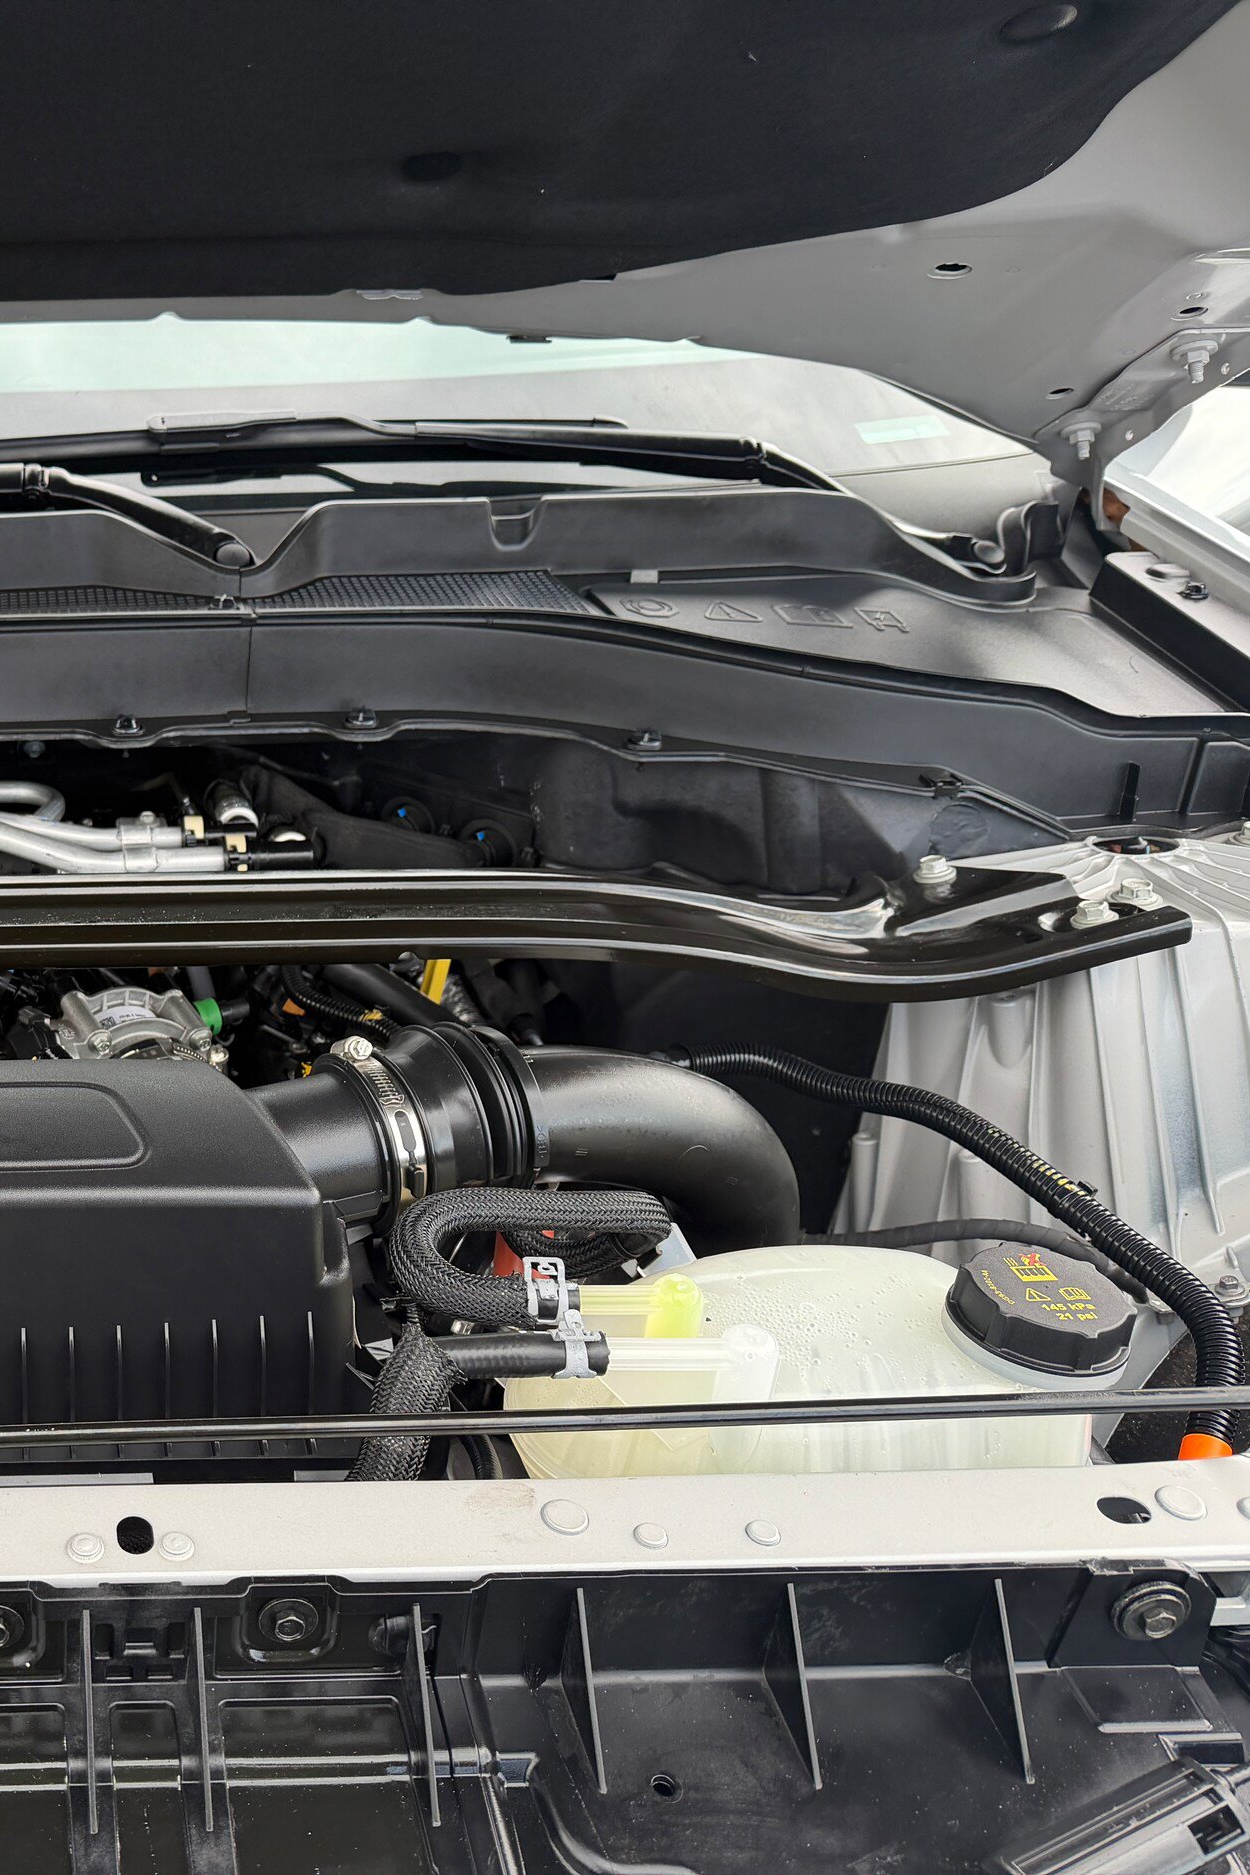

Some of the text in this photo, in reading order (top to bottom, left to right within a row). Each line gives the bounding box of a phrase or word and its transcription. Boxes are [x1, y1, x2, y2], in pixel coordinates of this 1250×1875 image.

[1041, 1303, 1096, 1311] 145 kPa
[1056, 1312, 1098, 1321] 21 psi
